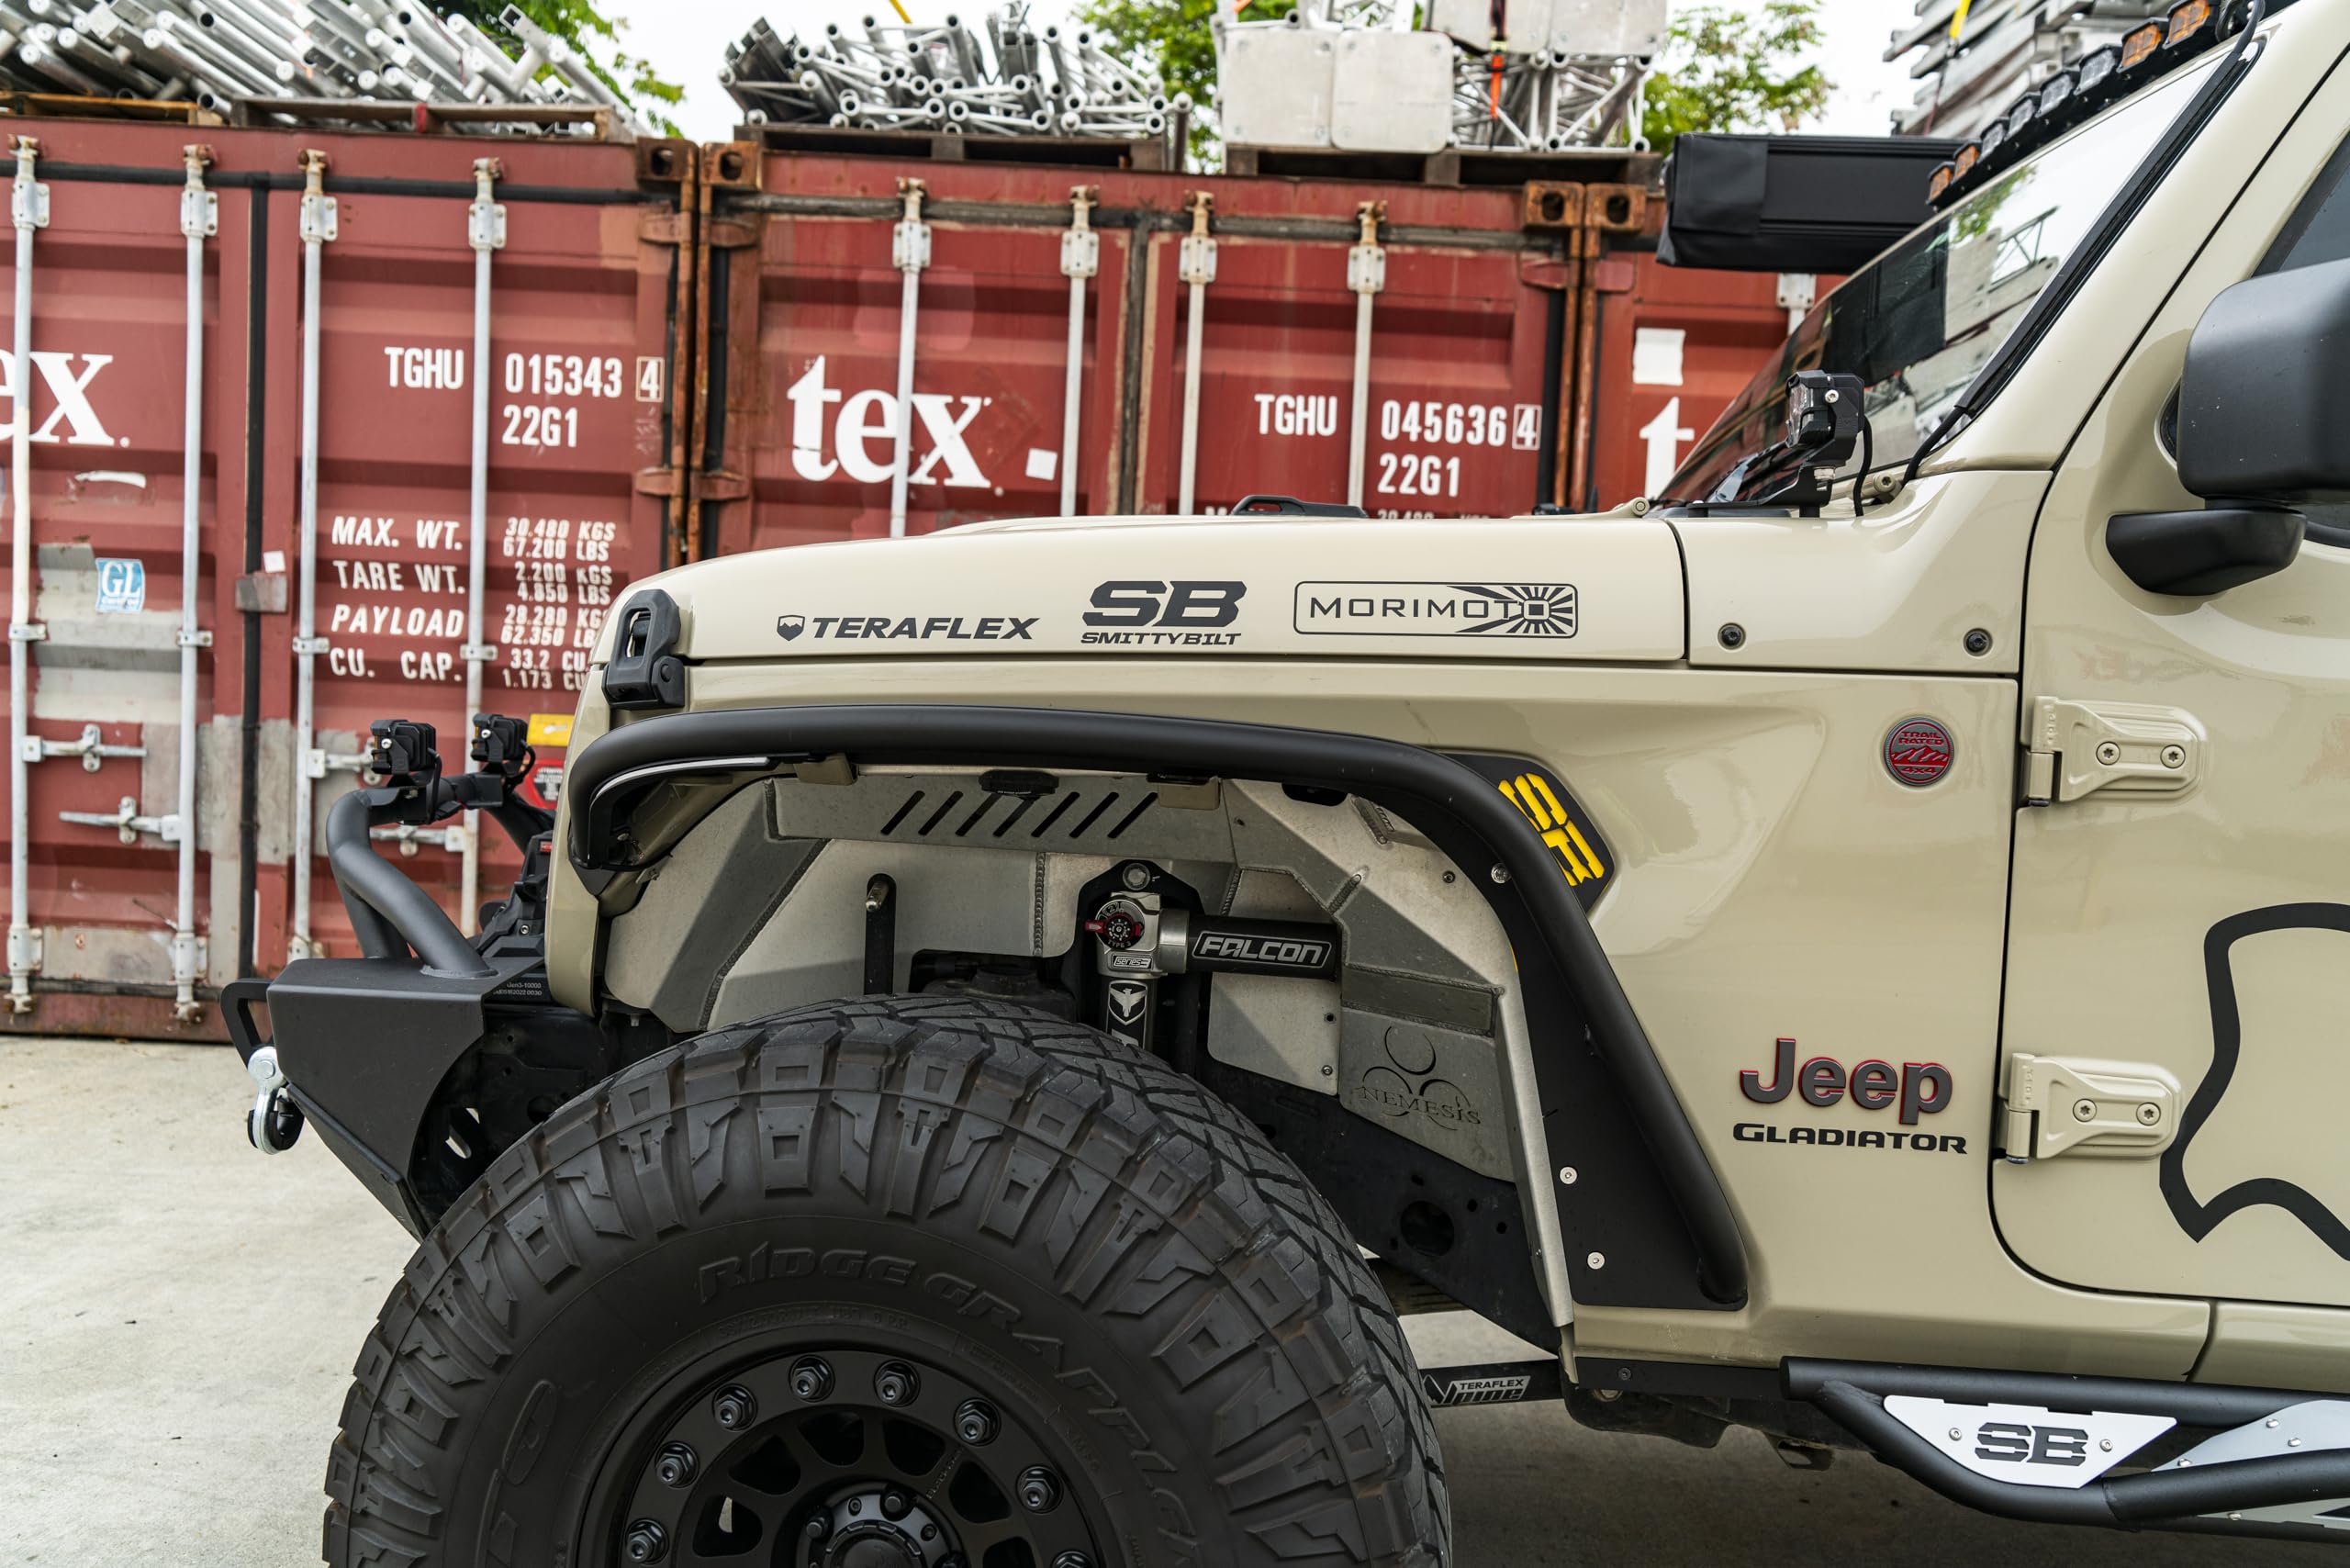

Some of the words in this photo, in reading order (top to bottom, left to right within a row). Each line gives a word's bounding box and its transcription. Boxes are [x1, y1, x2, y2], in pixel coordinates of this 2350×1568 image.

[384, 347, 464, 389] TGHU
[505, 353, 623, 398] 015343
[639, 359, 660, 399] 4
[502, 404, 578, 447] 22G1
[1254, 394, 1338, 437] TGHU
[1381, 399, 1508, 446] 045636
[1517, 407, 1538, 446] 4
[1378, 453, 1460, 498] 22G1
[331, 516, 400, 547] MAX.
[416, 519, 463, 551] WT.
[505, 517, 570, 538] 30.480
[578, 521, 616, 542] KGS
[576, 540, 610, 562] LBS
[332, 560, 405, 591] TARE
[415, 564, 465, 594] WT.
[514, 561, 567, 582] 2.200
[576, 565, 613, 586] KGS
[577, 585, 611, 606] LBS
[1081, 580, 1248, 627] SB
[330, 603, 464, 638] PAYLOAD
[812, 617, 1040, 640] TERAFLEX
[1080, 633, 1242, 646] SMITTYBILT
[330, 647, 375, 678] CU.
[400, 650, 462, 681] CAP.
[510, 648, 551, 669] 33.2
[502, 668, 553, 689] 1.173
[1898, 737, 1944, 745] RATED
[1199, 935, 1323, 964] FALCON
[1740, 1037, 1953, 1126] Jeep
[1732, 1123, 1968, 1155] GLADIATOR
[1460, 1379, 1525, 1391] TERAFLEX
[1975, 1422, 2089, 1467] SB
